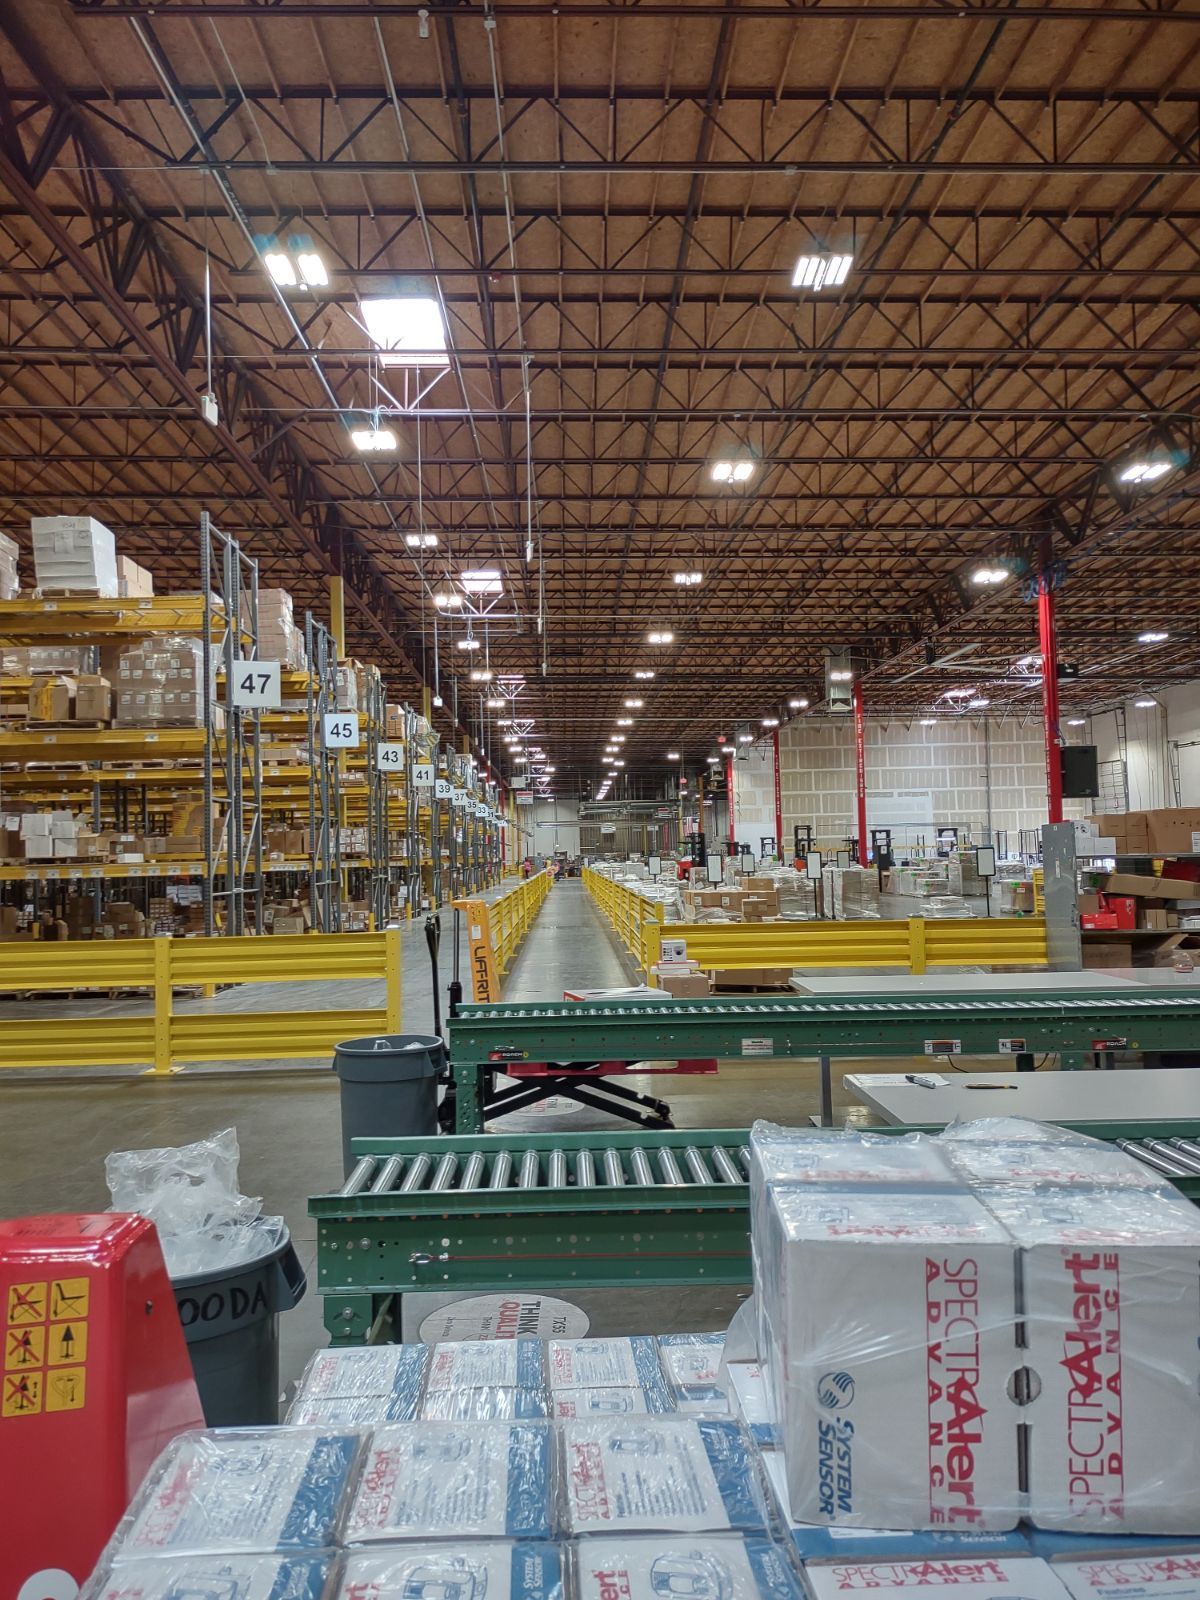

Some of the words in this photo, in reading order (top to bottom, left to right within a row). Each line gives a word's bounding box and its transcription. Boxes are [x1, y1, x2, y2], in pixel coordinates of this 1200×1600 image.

[240, 673, 271, 694] 47
[330, 722, 353, 739] 45
[381, 750, 399, 763] 43
[416, 770, 430, 780] 41
[438, 784, 451, 794] 39
[454, 793, 465, 801] 37
[467, 801, 477, 809] 35
[478, 806, 487, 814] 33
[474, 945, 490, 1004] LIFT-RIT
[177, 1281, 269, 1327] OODA
[495, 1301, 520, 1340] QUALIT
[517, 1300, 542, 1336] THINK
[926, 1257, 945, 1525] ADVANCE
[1103, 1252, 1125, 1520] ADVANCE
[818, 1419, 837, 1517] SENSOR
[836, 1416, 855, 1514] SYSTEM
[838, 1576, 1010, 1590] ADVANCE
